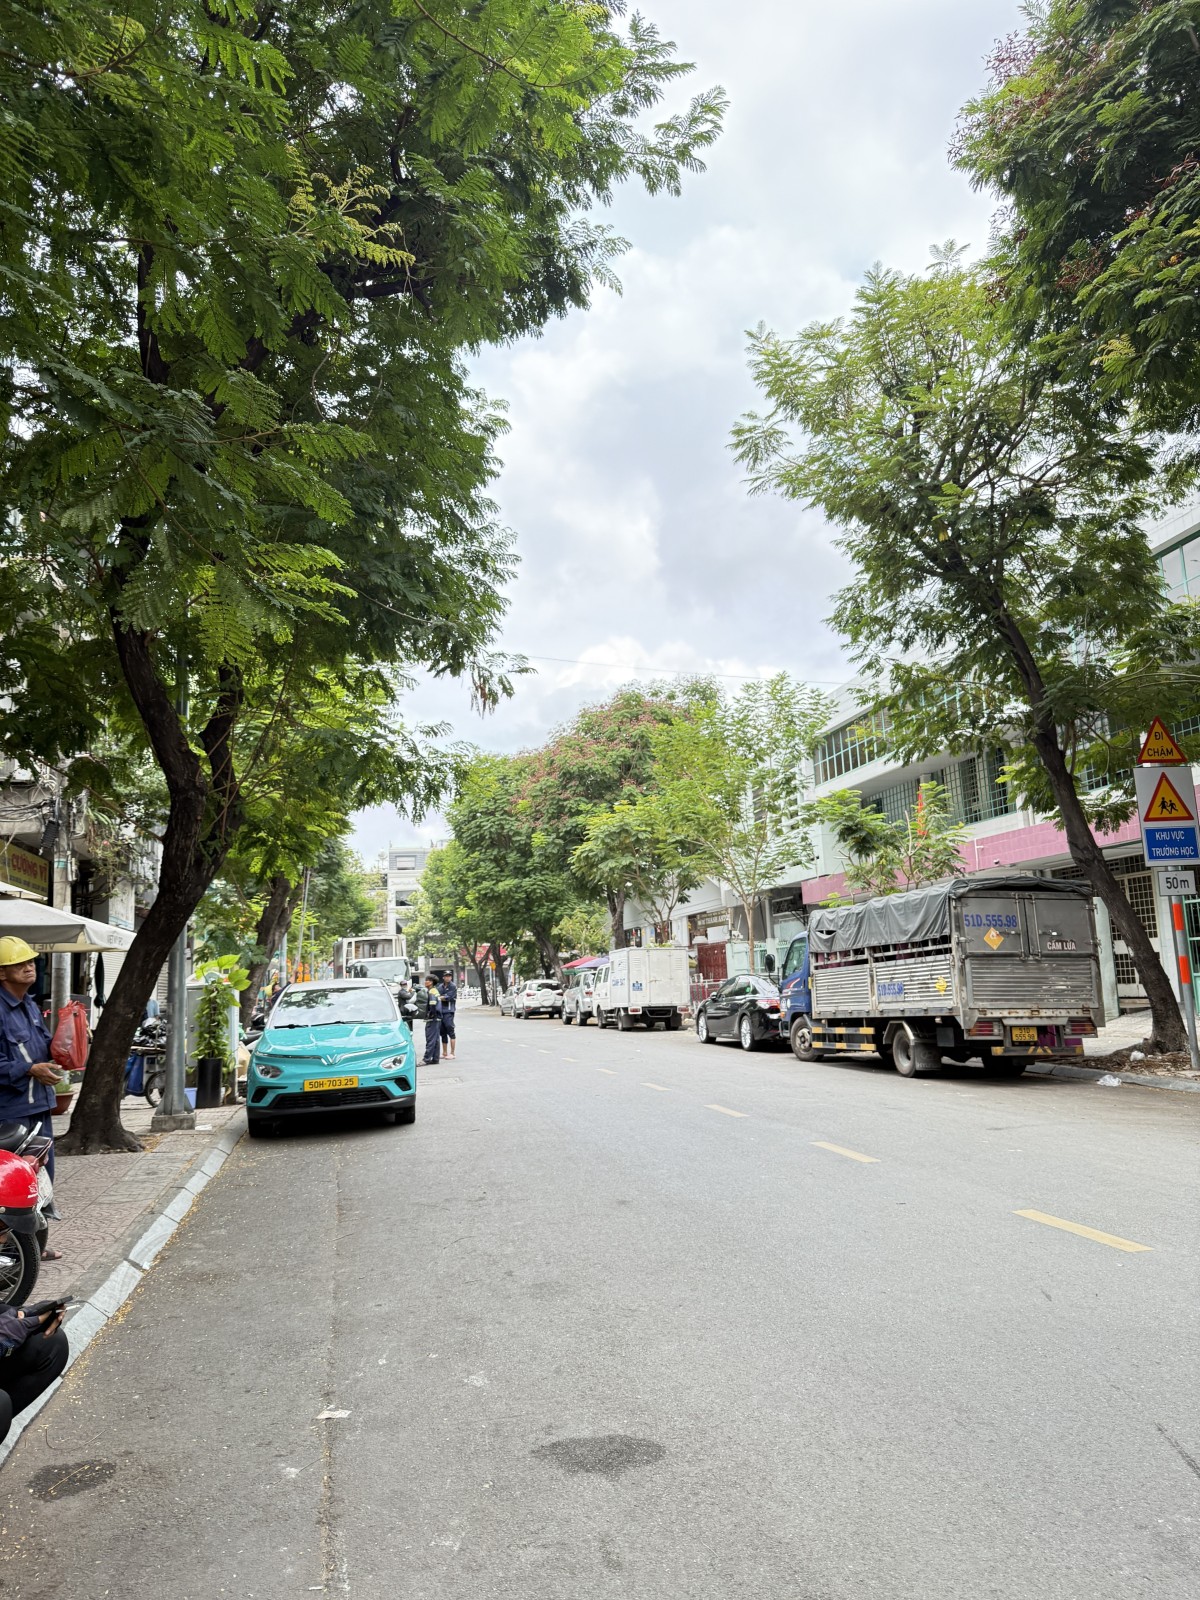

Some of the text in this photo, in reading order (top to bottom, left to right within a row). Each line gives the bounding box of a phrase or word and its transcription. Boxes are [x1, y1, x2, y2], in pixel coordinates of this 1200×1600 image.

[1154, 731, 1164, 741] ĐI
[1147, 745, 1174, 759] CHẬM
[1155, 830, 1185, 842] KHU VỰC
[1151, 844, 1195, 858] TRƯỜNG HỌC
[964, 913, 1017, 928] 51D.555.98
[1047, 939, 1062, 951] CẤM
